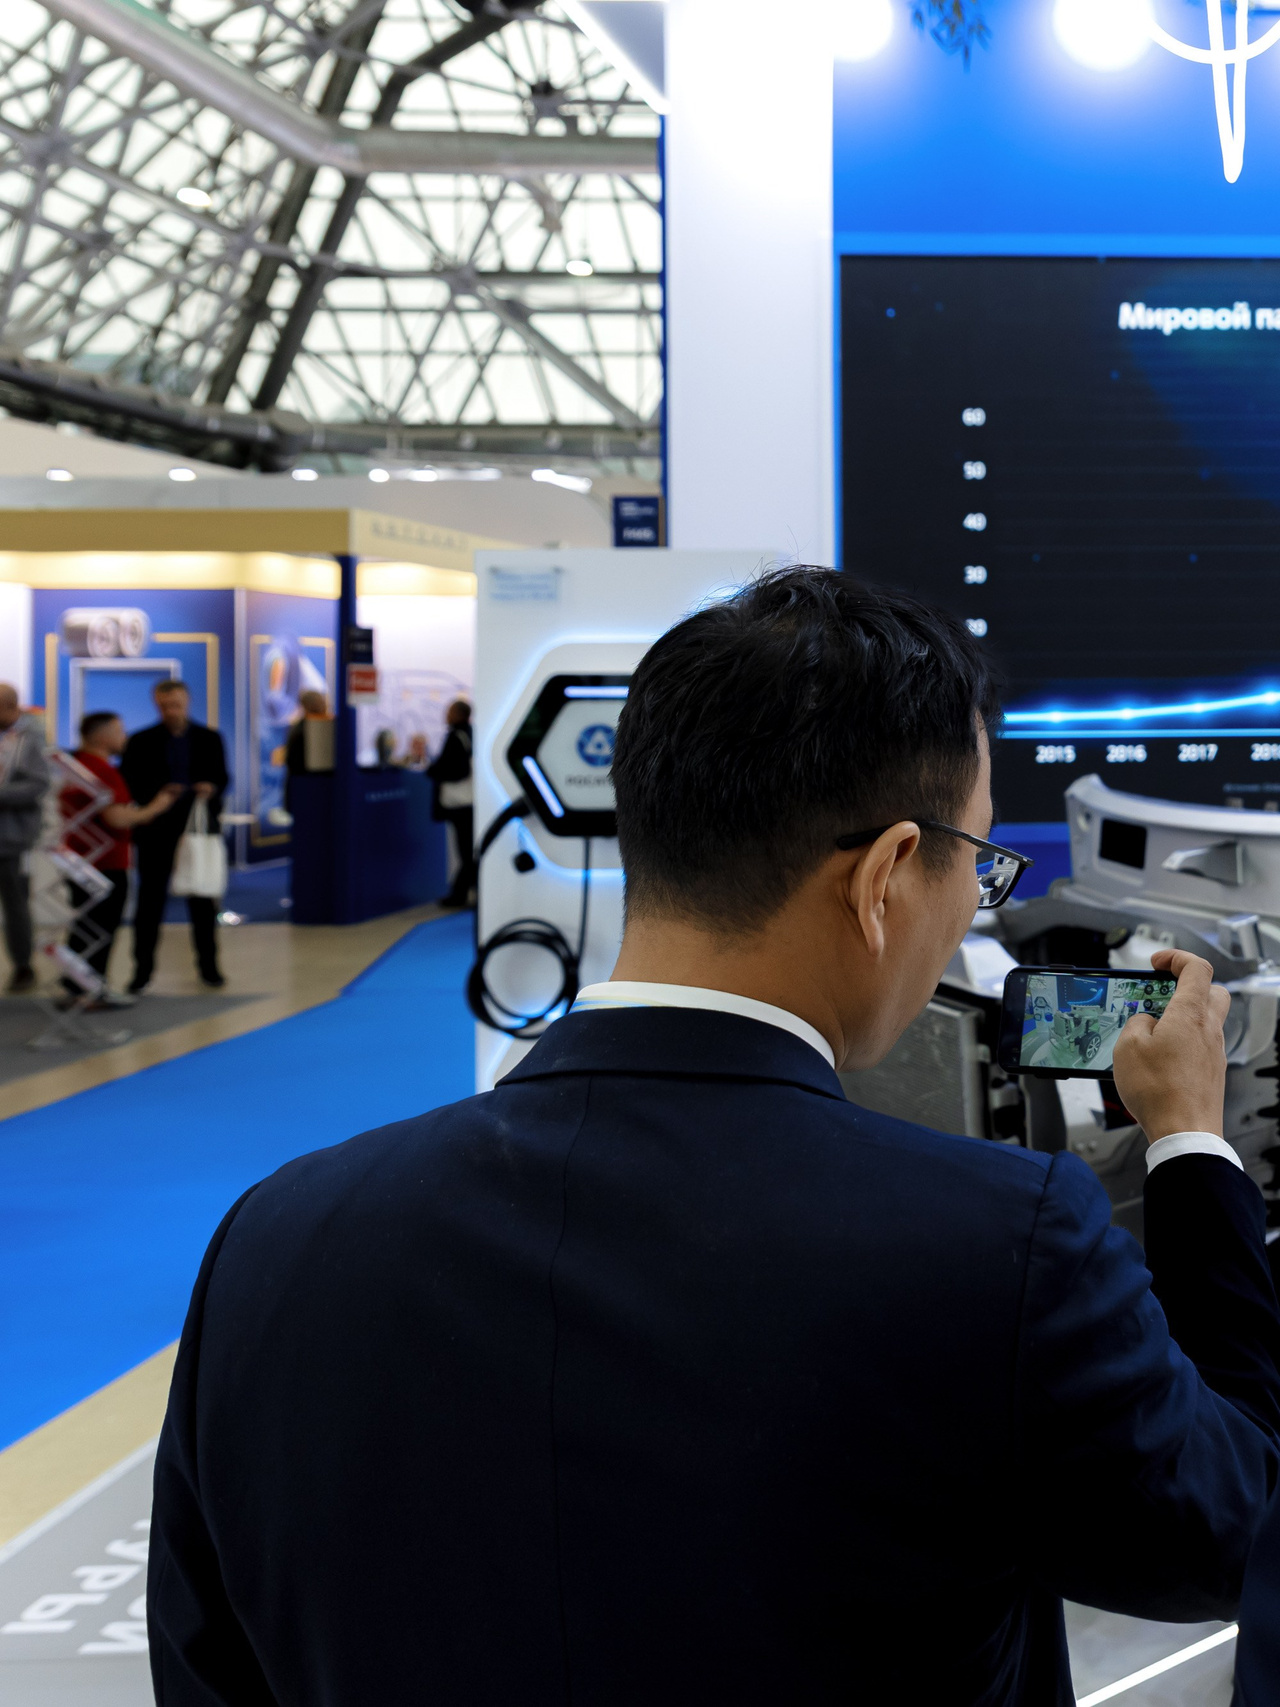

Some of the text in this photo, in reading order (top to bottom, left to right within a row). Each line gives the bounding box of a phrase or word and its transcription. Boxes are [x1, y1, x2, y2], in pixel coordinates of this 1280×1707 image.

[1118, 302, 1251, 336] Мировой
[962, 407, 987, 427] 60
[963, 461, 987, 480] 50
[962, 512, 988, 531] 40
[963, 565, 988, 585] 30
[1035, 745, 1076, 763] 2015
[1106, 744, 1147, 763] 2016
[1178, 743, 1218, 762] 2017
[0, 1518, 150, 1635] УРЫ
